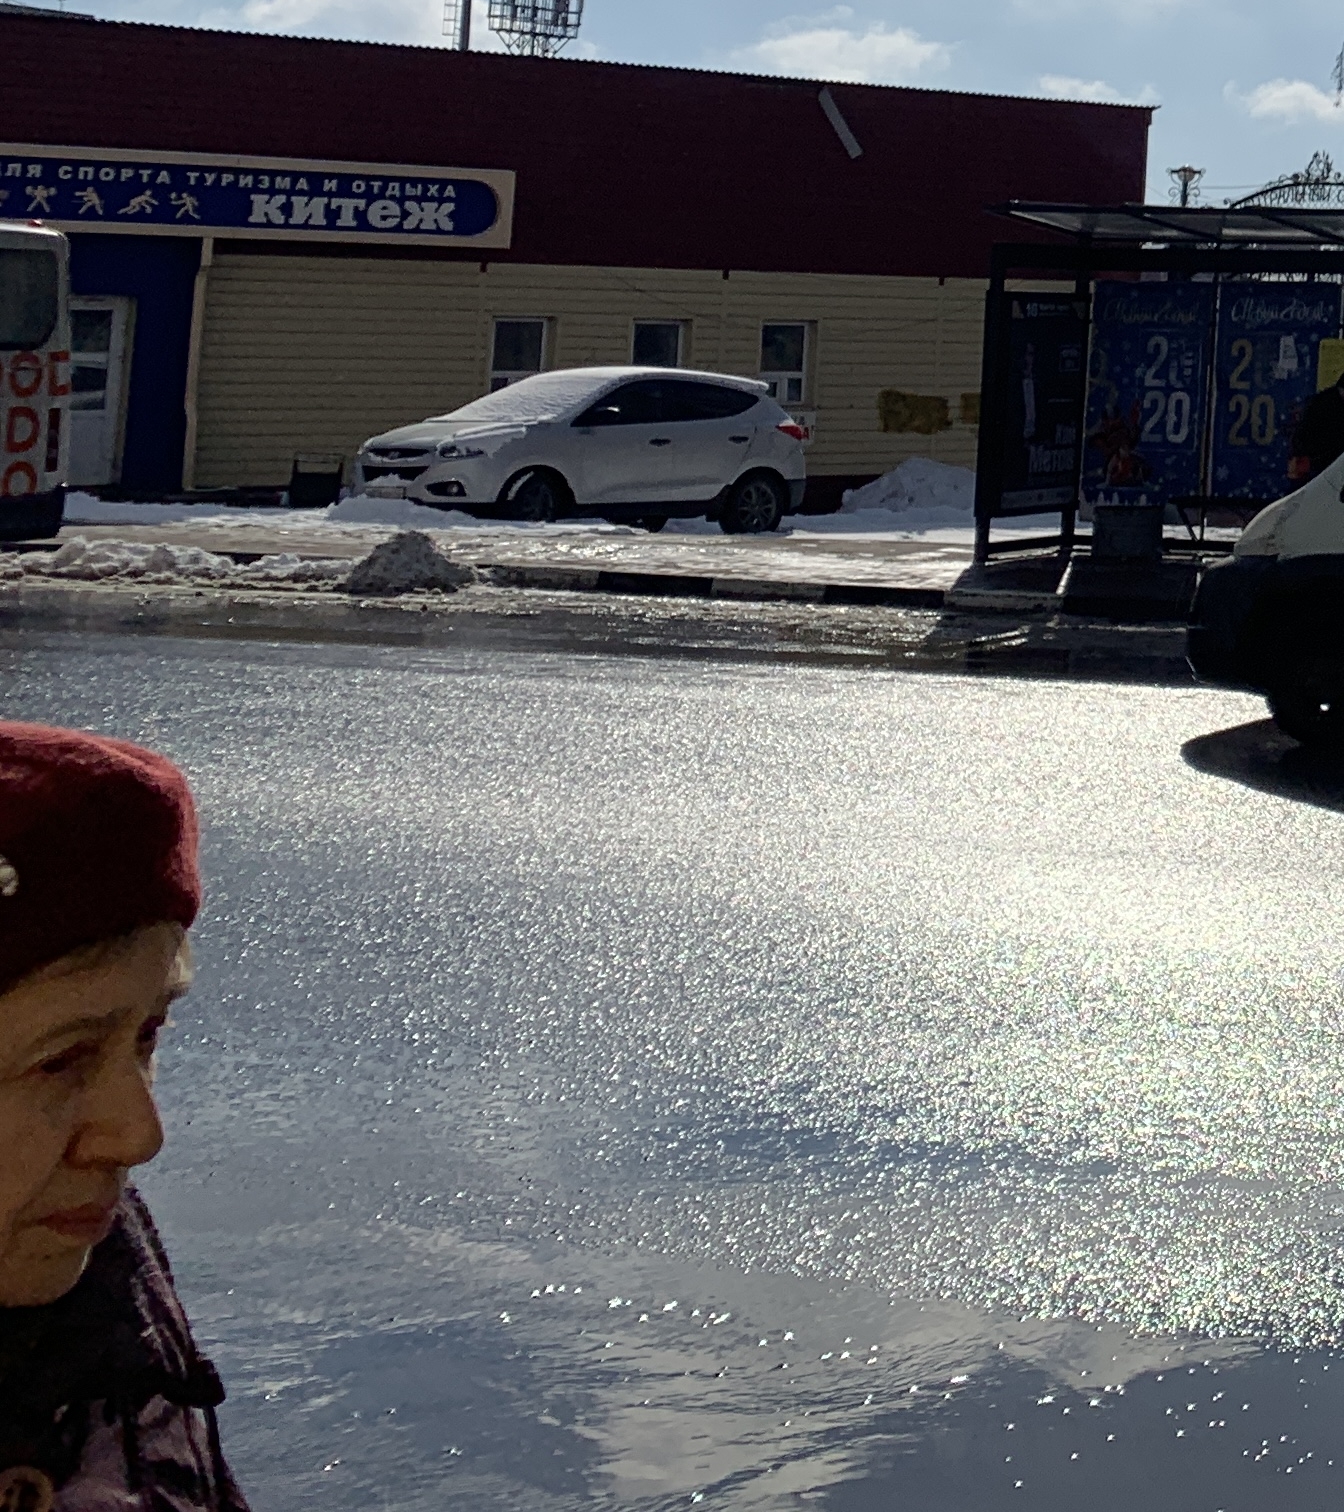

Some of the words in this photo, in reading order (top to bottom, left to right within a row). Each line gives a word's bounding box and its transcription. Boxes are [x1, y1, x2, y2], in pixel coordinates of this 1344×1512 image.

[0, 161, 43, 178] ЛЯ
[57, 165, 171, 185] СПОРТА
[187, 171, 310, 192] ТУРИЗМА
[322, 179, 338, 192] И
[351, 180, 456, 199] ОТДЫХА
[1141, 390, 1191, 444] 20
[1227, 393, 1276, 447] 20
